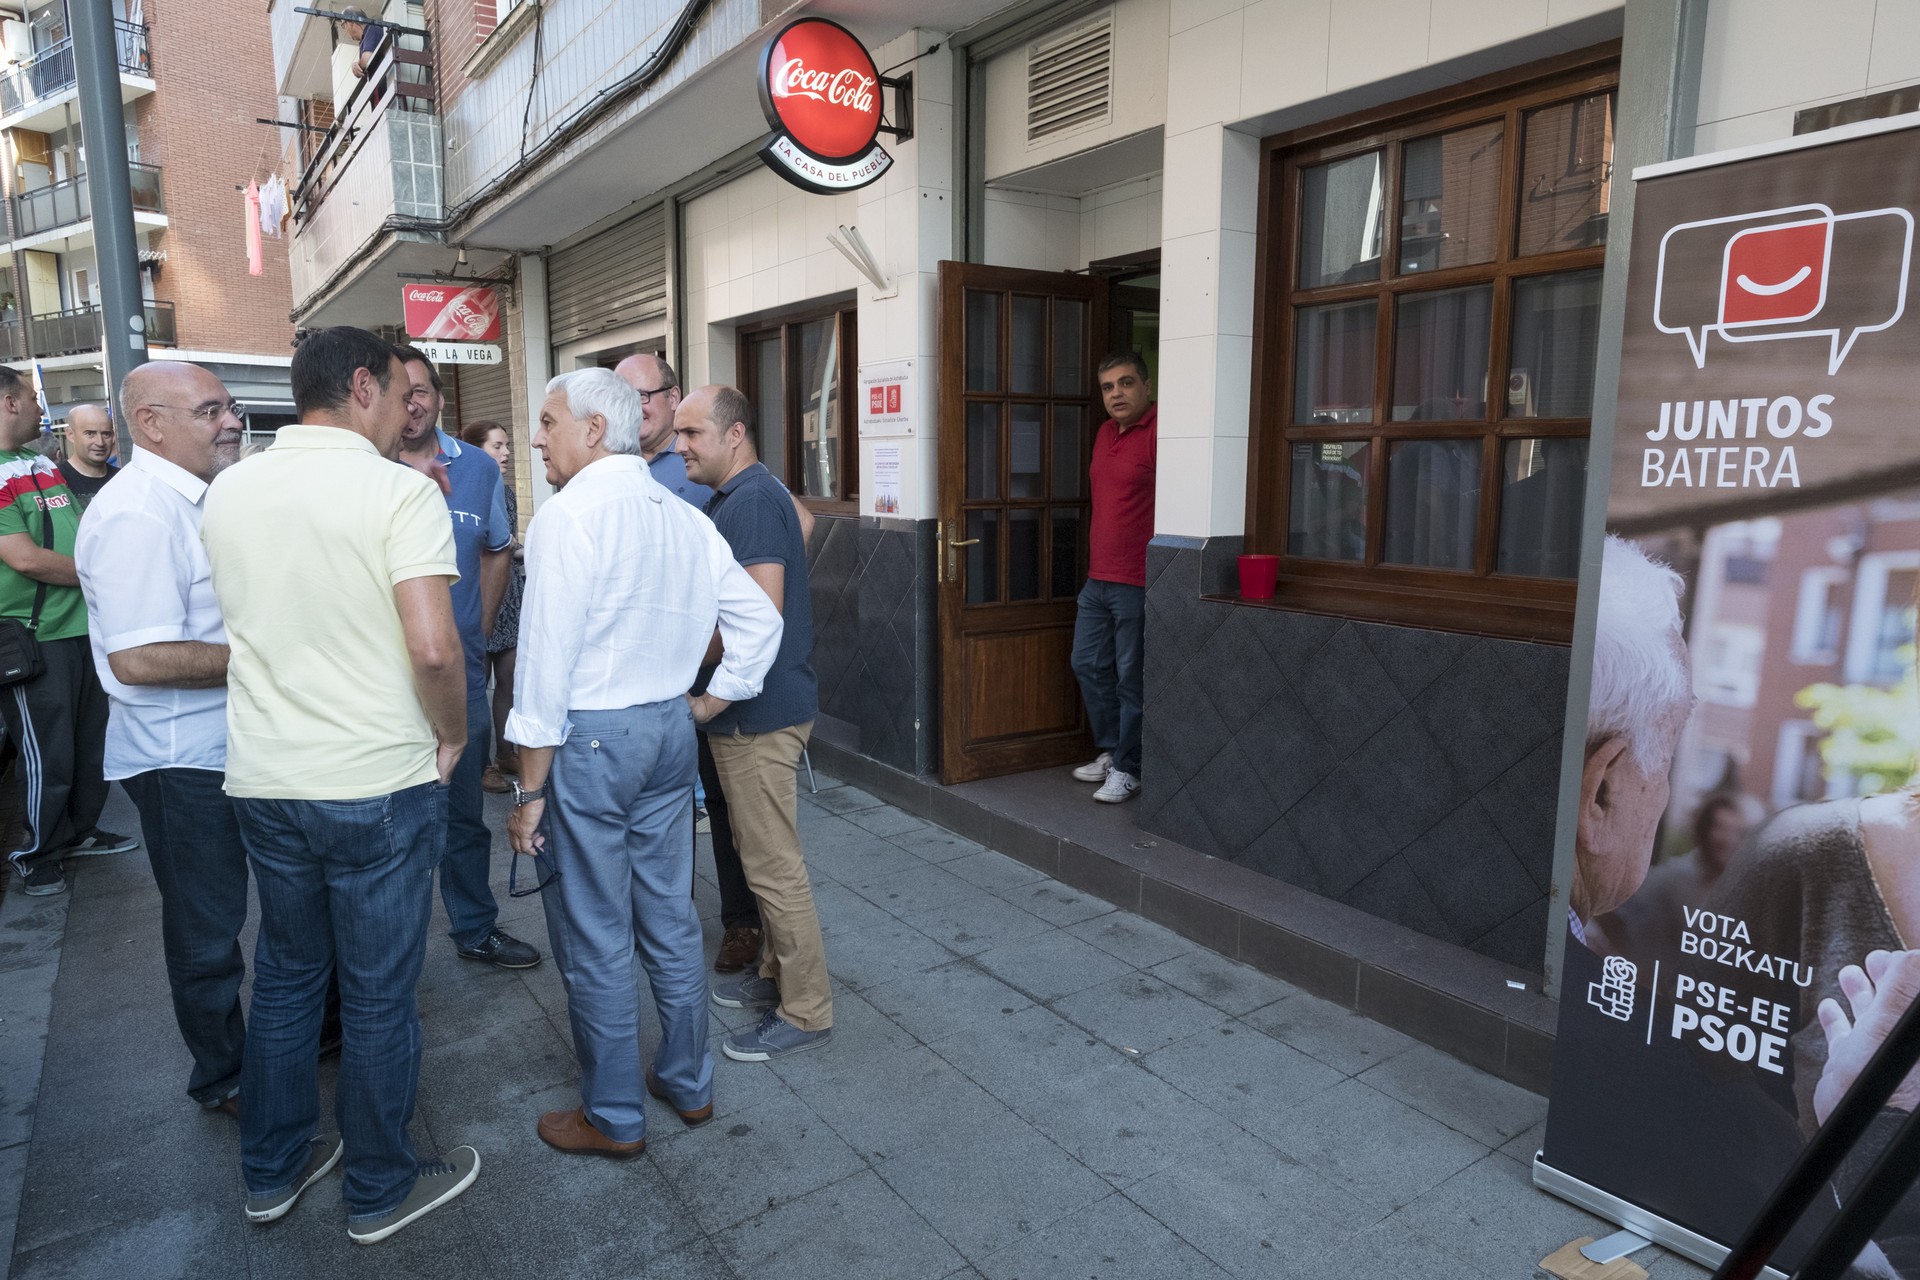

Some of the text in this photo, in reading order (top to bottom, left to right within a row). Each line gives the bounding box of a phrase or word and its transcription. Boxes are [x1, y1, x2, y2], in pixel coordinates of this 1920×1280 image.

[775, 58, 875, 113] Coca-Cola
[778, 141, 887, 182] LA CASA DEL PUEBLO
[409, 290, 446, 303] Coca-Cola
[445, 349, 458, 360] LA
[467, 349, 493, 360] VEGA
[871, 400, 883, 409] PSOE
[1646, 394, 1836, 441] JUNTOS
[1641, 446, 1801, 488] BATERA
[1683, 905, 1751, 944] VOTA
[1680, 931, 1814, 987] BOZKATU
[1676, 973, 1791, 1033] PSE-EE
[1671, 1003, 1788, 1075] PSOE
